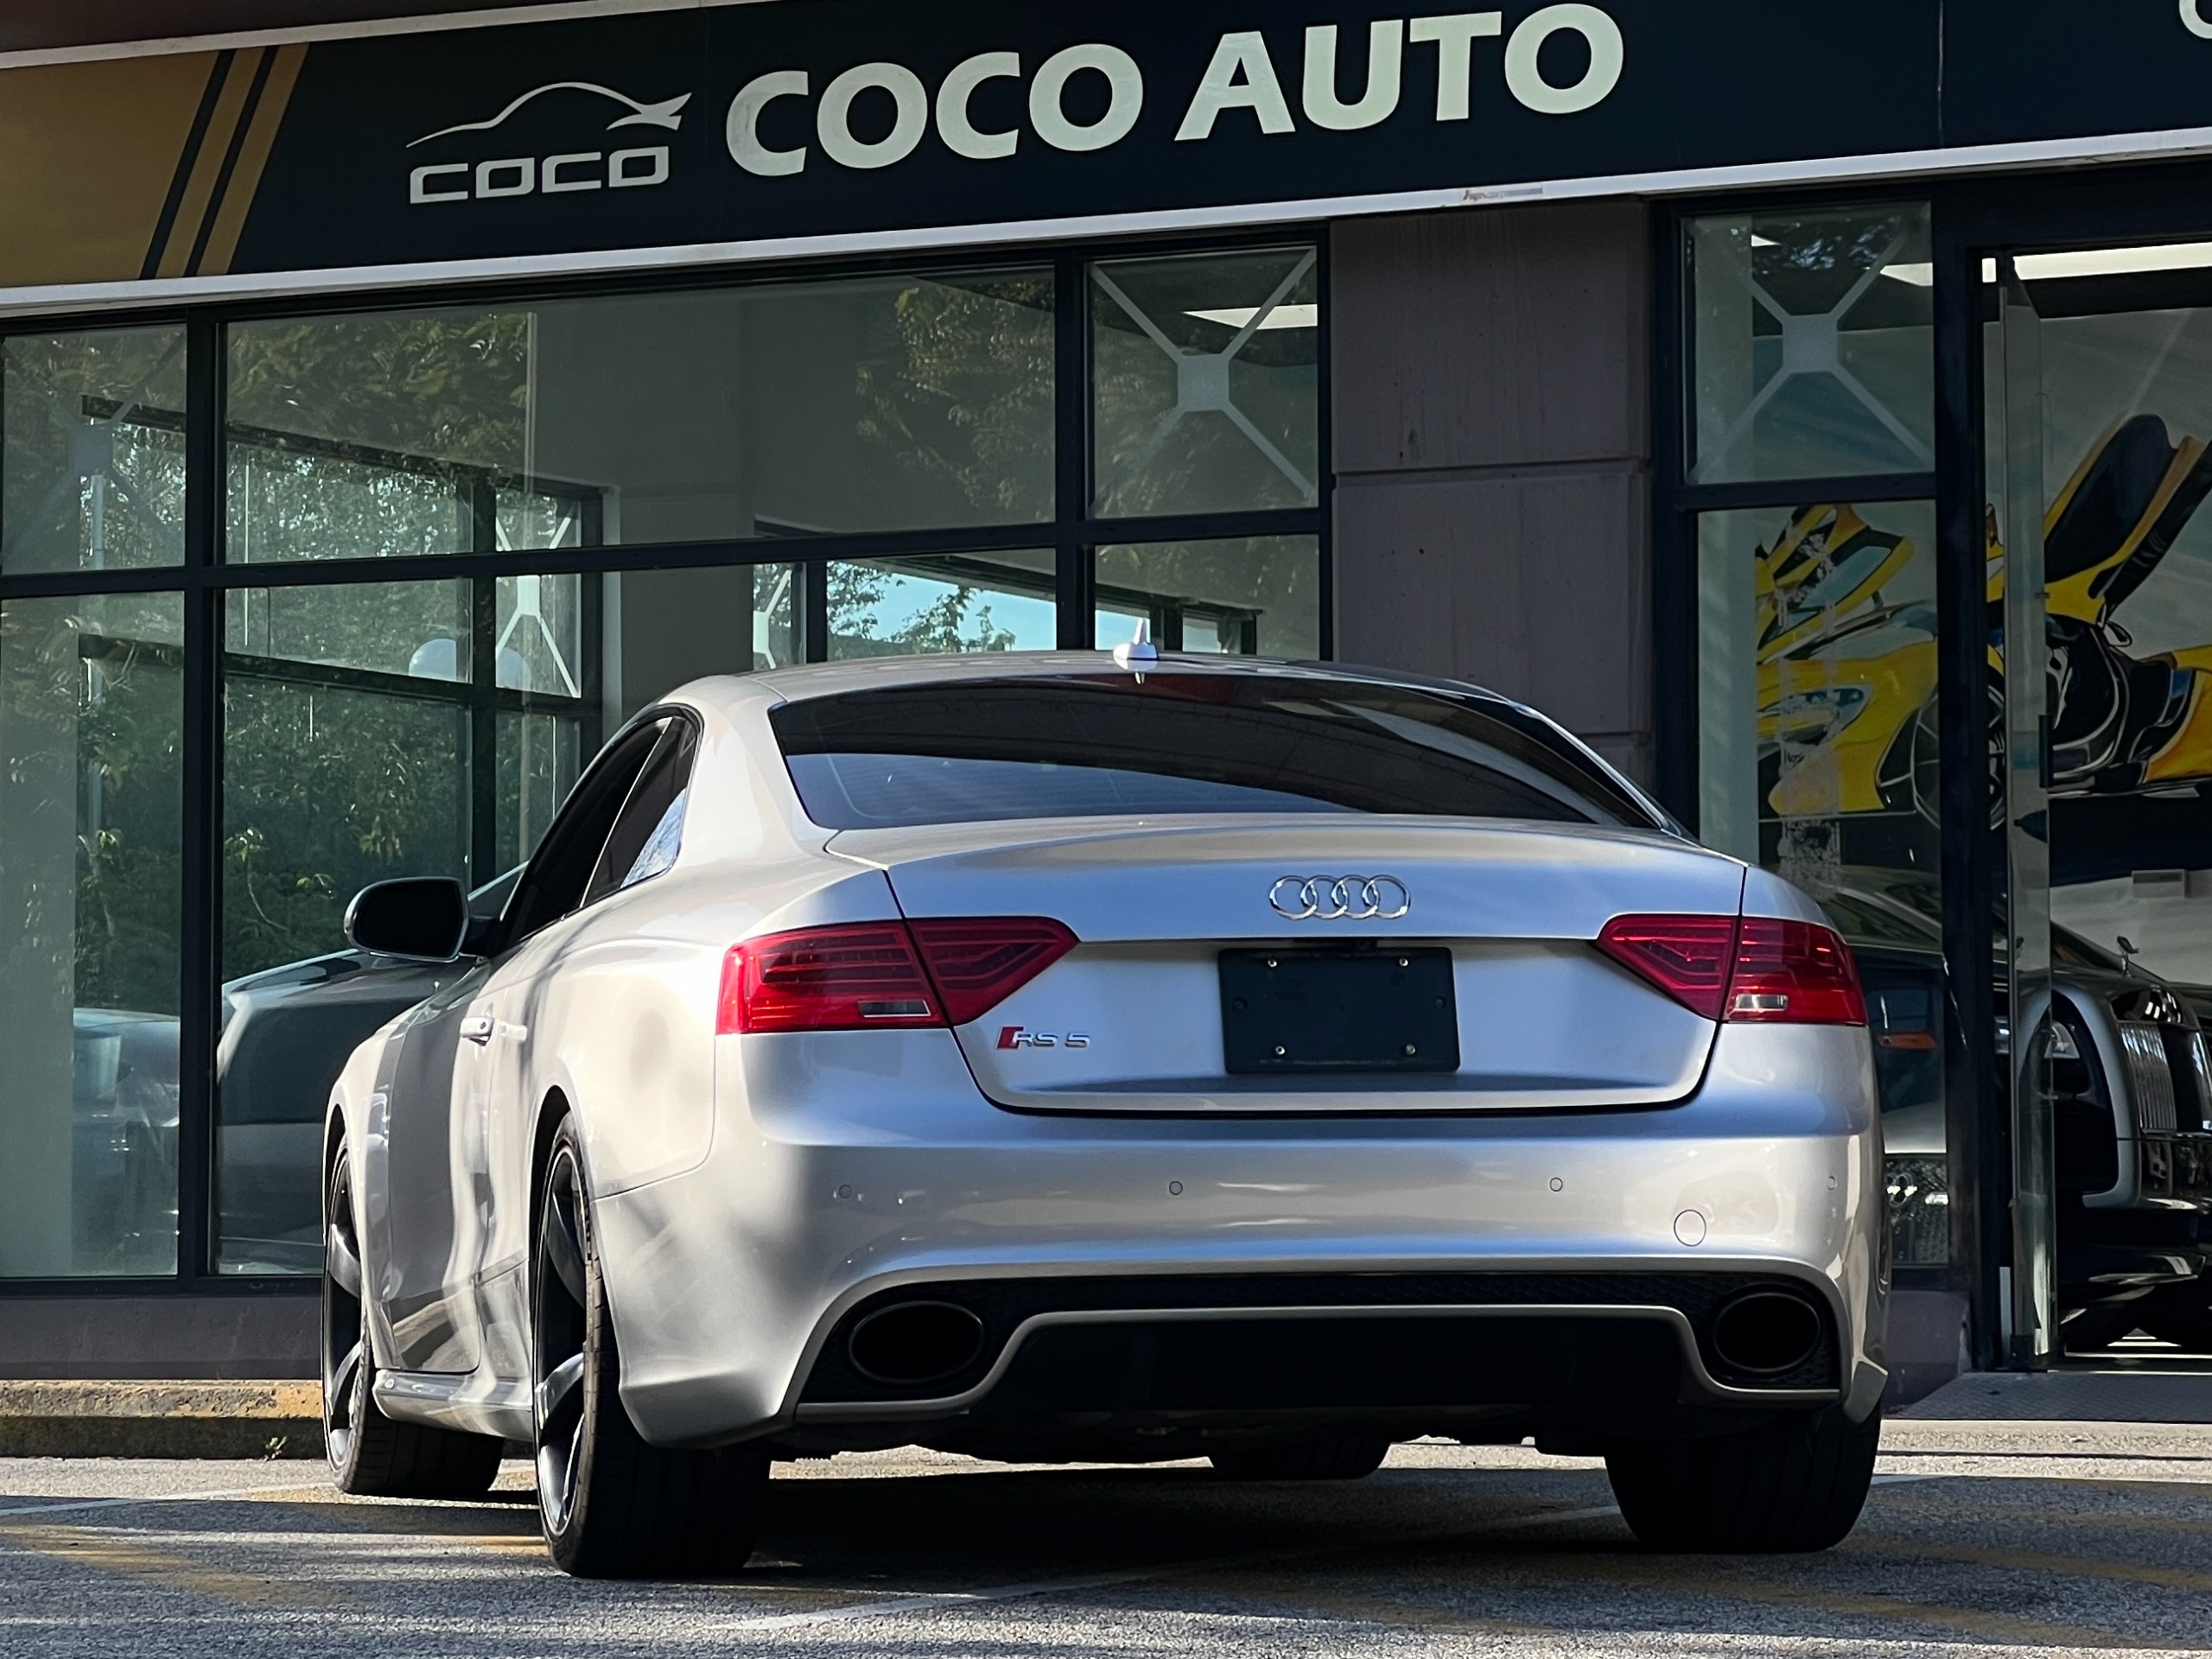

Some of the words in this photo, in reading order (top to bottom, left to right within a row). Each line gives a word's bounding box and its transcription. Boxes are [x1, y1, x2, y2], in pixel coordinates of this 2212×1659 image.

[726, 43, 1144, 176] COCO
[1173, 3, 1624, 142] AUTO
[410, 146, 669, 204] COCO
